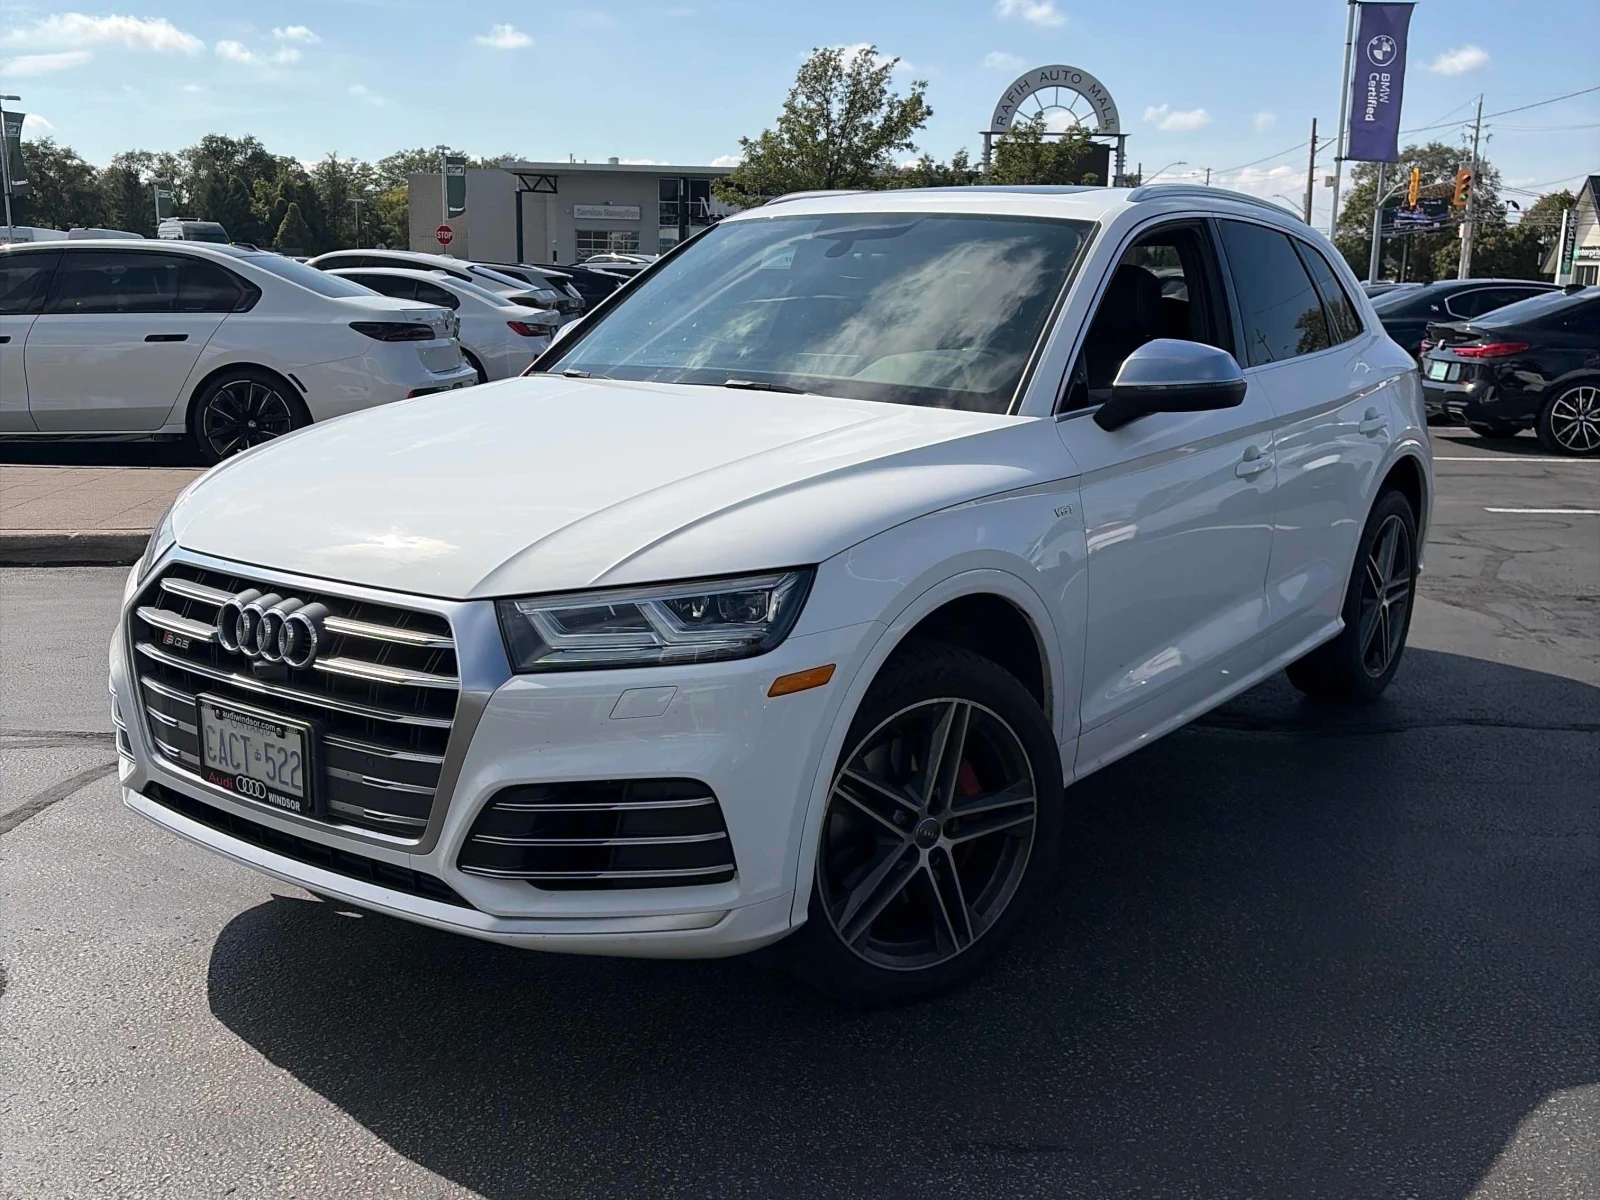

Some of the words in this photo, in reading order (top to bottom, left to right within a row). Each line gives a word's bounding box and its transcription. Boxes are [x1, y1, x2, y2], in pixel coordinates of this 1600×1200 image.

[997, 80, 1030, 125] RAFIH
[1039, 70, 1082, 84] AUTO
[1365, 73, 1379, 121] Certified
[1380, 73, 1391, 104] BMW
[437, 231, 453, 239] STOP
[163, 631, 190, 649] SQ5
[222, 711, 276, 732] audiwindsor.com
[206, 725, 250, 773] CACT
[264, 741, 302, 790] 522
[208, 772, 233, 790] Audi
[268, 792, 301, 812] WINDSOR
